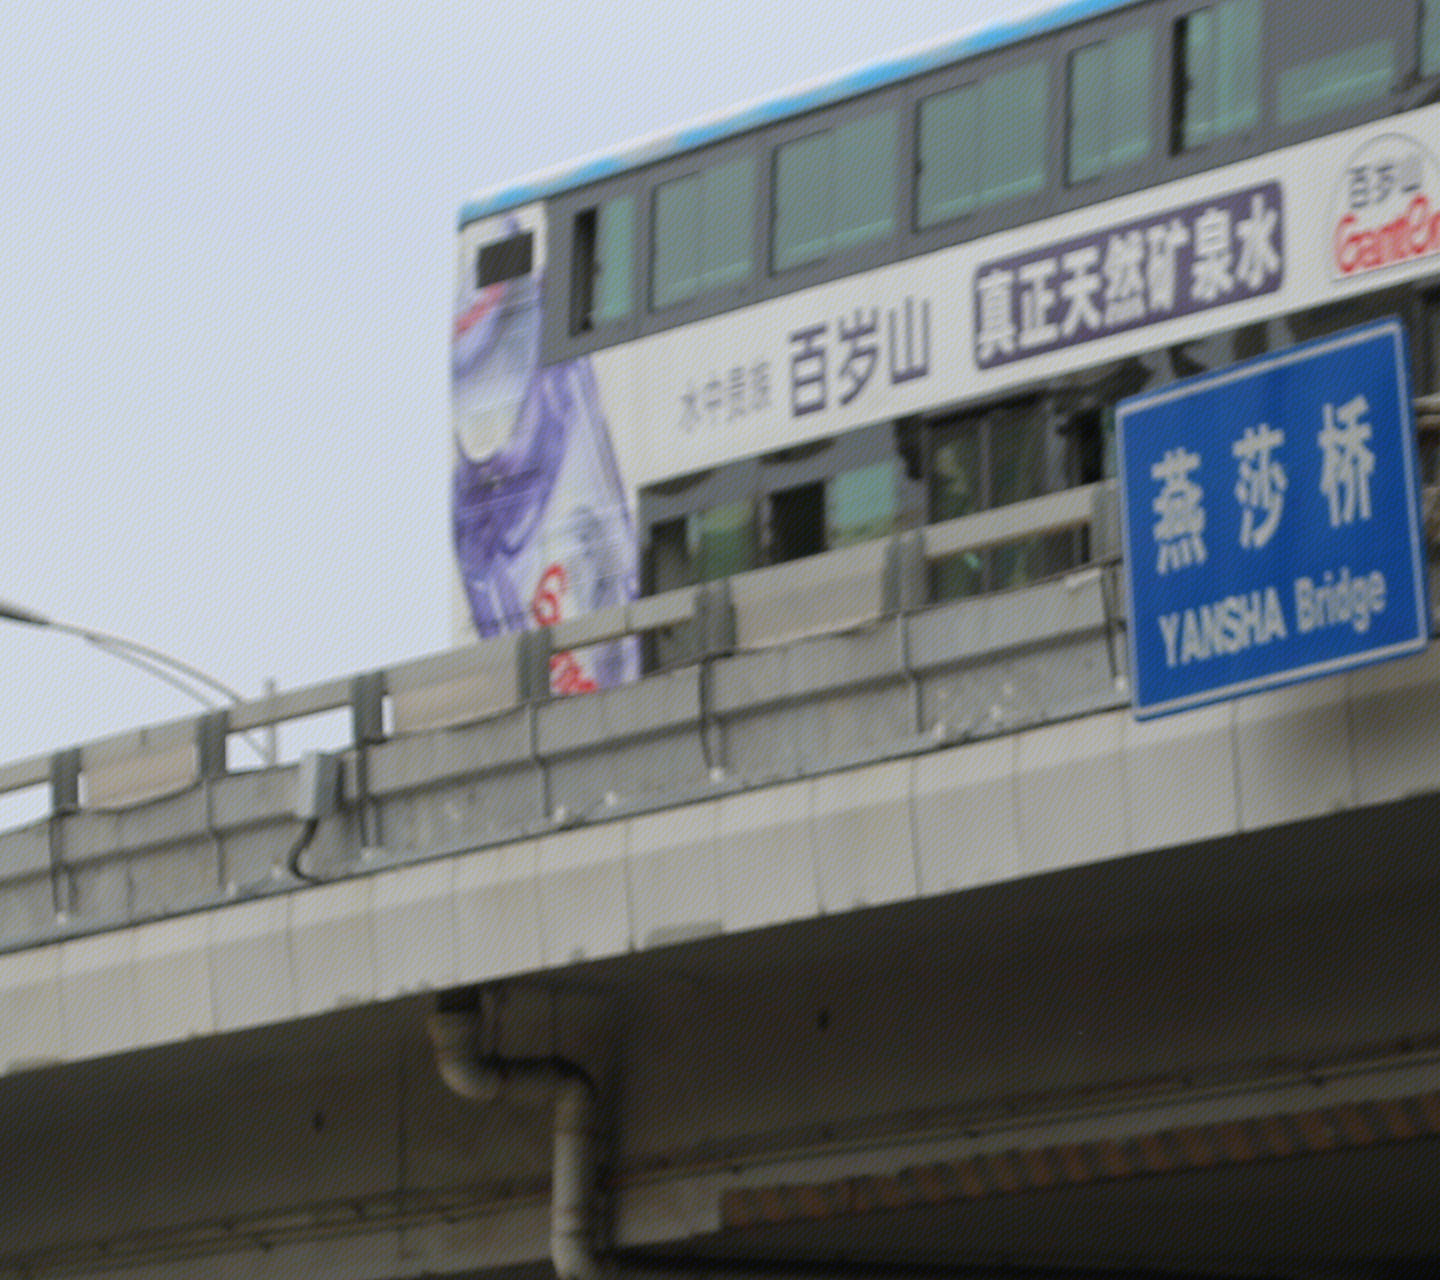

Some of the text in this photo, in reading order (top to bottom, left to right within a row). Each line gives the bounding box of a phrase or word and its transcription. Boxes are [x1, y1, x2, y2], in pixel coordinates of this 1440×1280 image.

[976, 192, 1281, 362] 真正天然矿泉水
[789, 295, 931, 418] 百岁山
[1150, 395, 1376, 575] 燕莎桥
[1158, 566, 1388, 668] YANSHA Bridge
